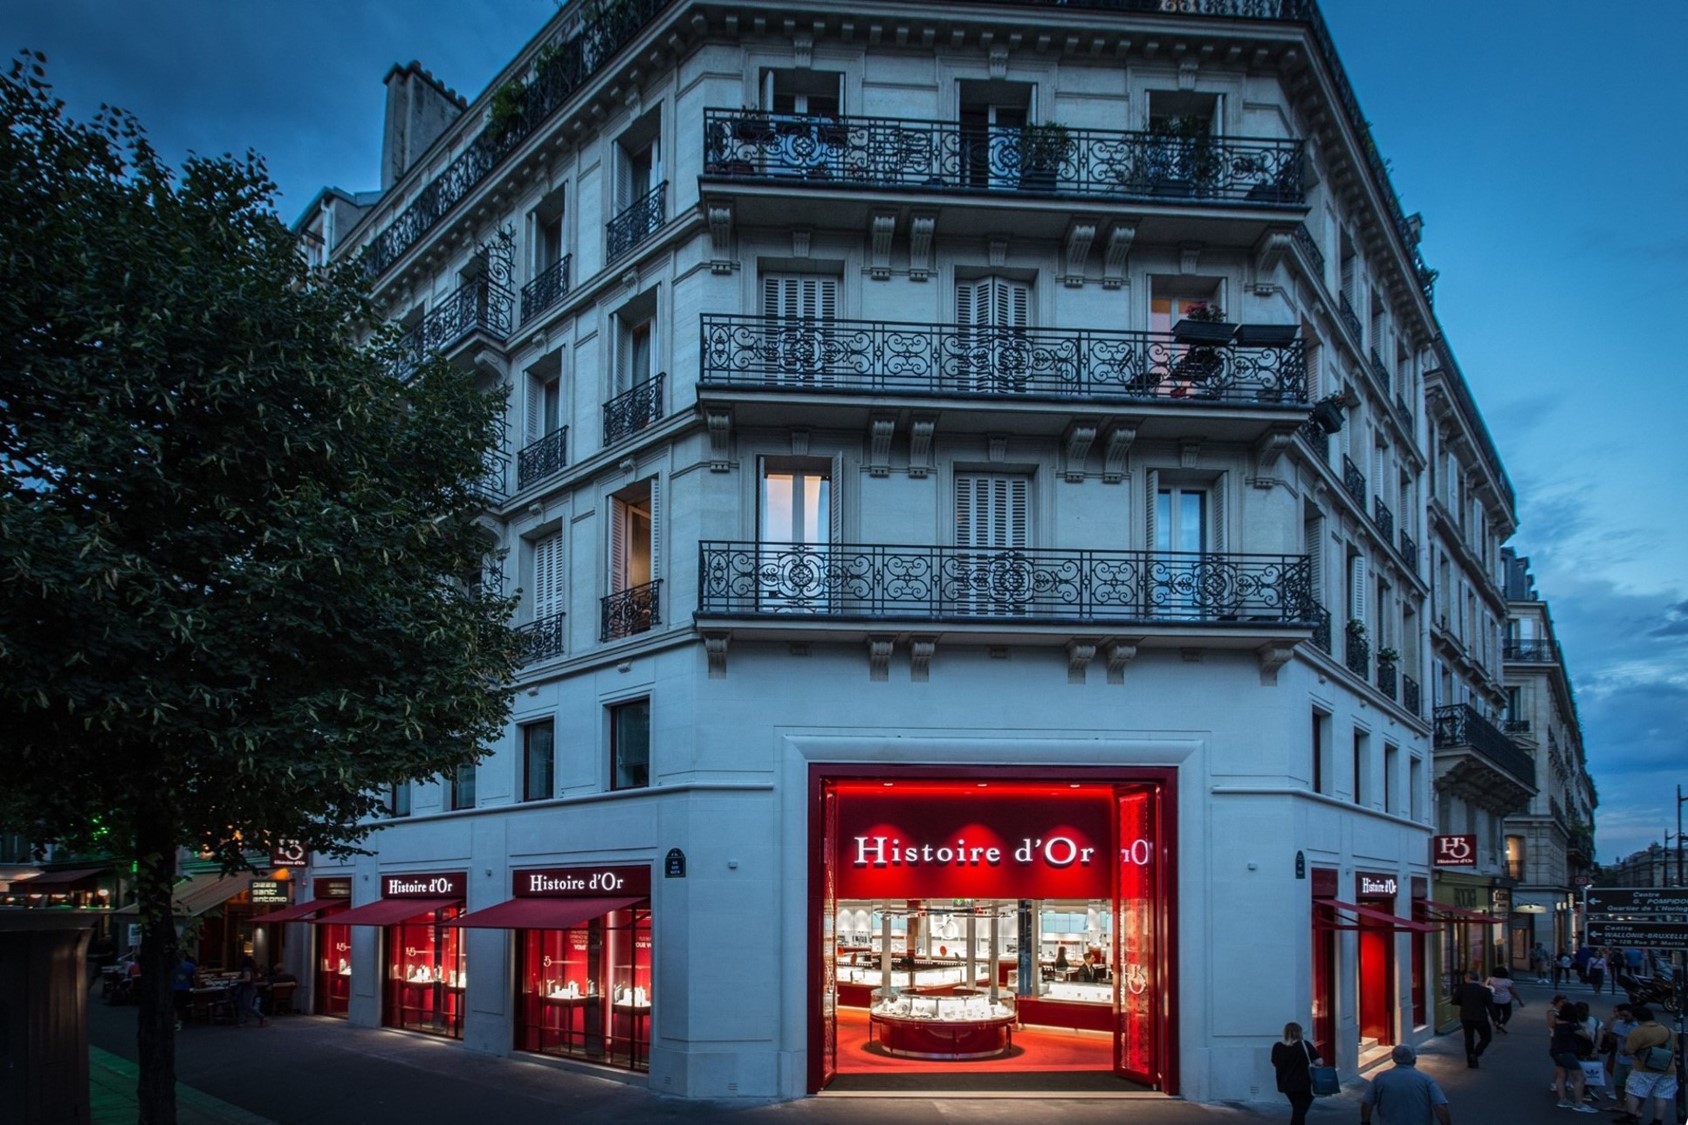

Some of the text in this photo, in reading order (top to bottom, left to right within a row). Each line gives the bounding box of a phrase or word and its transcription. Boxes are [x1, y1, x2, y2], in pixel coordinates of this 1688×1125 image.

[854, 836, 1094, 865] Histoire d'Or
[388, 877, 453, 894] Histoire d'Or
[530, 872, 624, 892] Histoire d'Or
[1362, 877, 1384, 893] Histoire
[1606, 904, 1640, 912] Quartier
